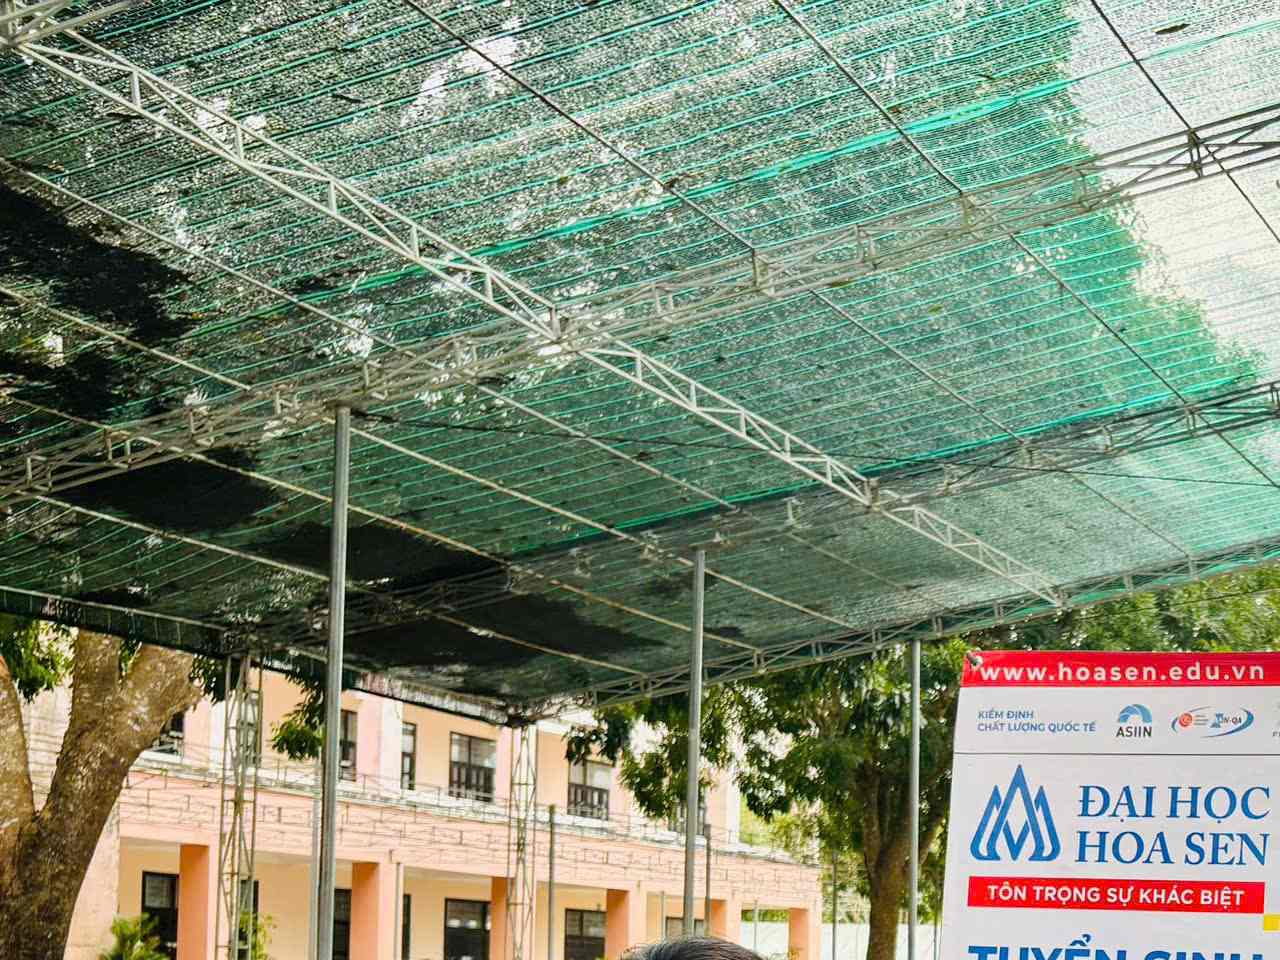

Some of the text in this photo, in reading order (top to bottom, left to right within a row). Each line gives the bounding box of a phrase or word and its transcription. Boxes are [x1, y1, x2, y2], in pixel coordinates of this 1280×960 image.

[980, 662, 1265, 681] www.hoasen.edu.vn
[1116, 725, 1152, 739] ASIIN
[1077, 785, 1272, 824] ĐẠI HỌC
[1075, 831, 1271, 866] HOA SEN
[987, 881, 1245, 910] TÔN TRỌNG SỰ KHÁC BIỆT
